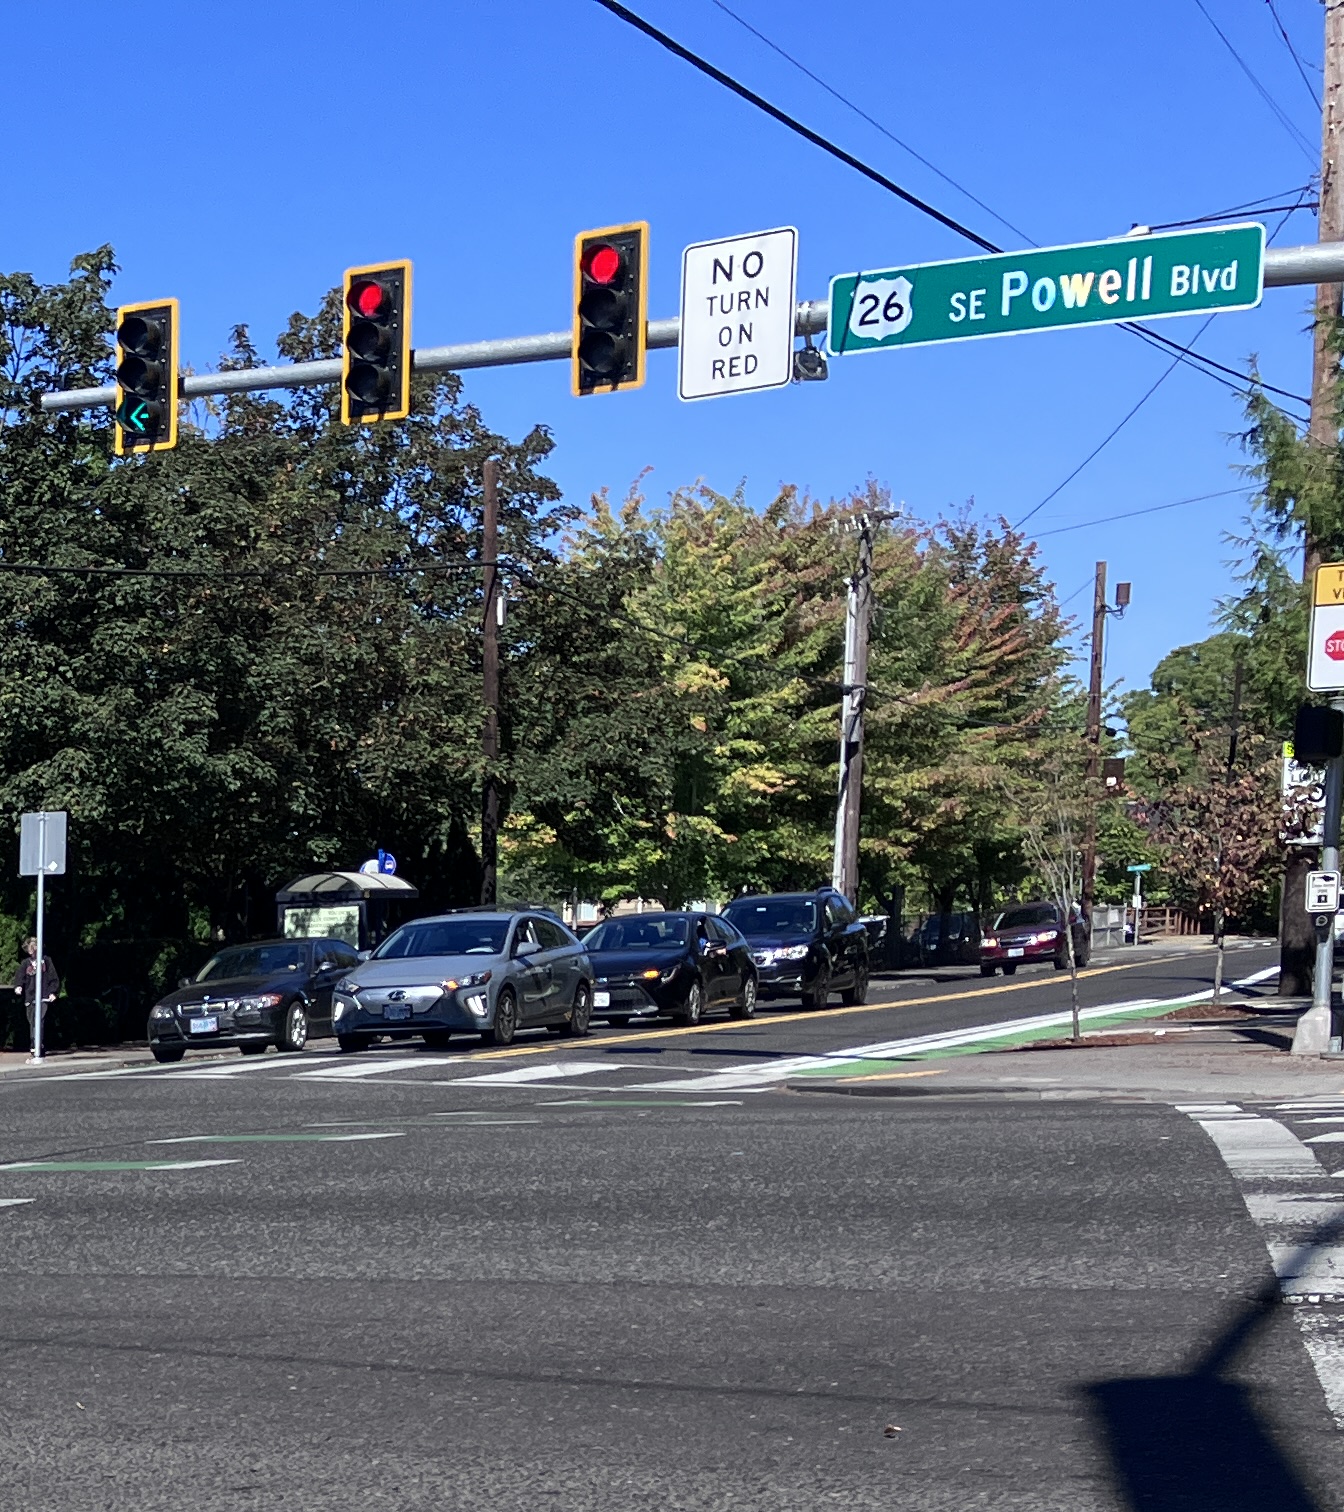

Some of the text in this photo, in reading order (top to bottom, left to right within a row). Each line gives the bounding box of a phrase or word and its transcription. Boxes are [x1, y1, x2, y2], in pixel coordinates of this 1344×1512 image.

[712, 251, 763, 285] NO
[706, 287, 770, 317] TURN
[858, 255, 1238, 327] 26 SE Powell Blvd
[718, 322, 753, 347] ON
[712, 354, 758, 380] RED
